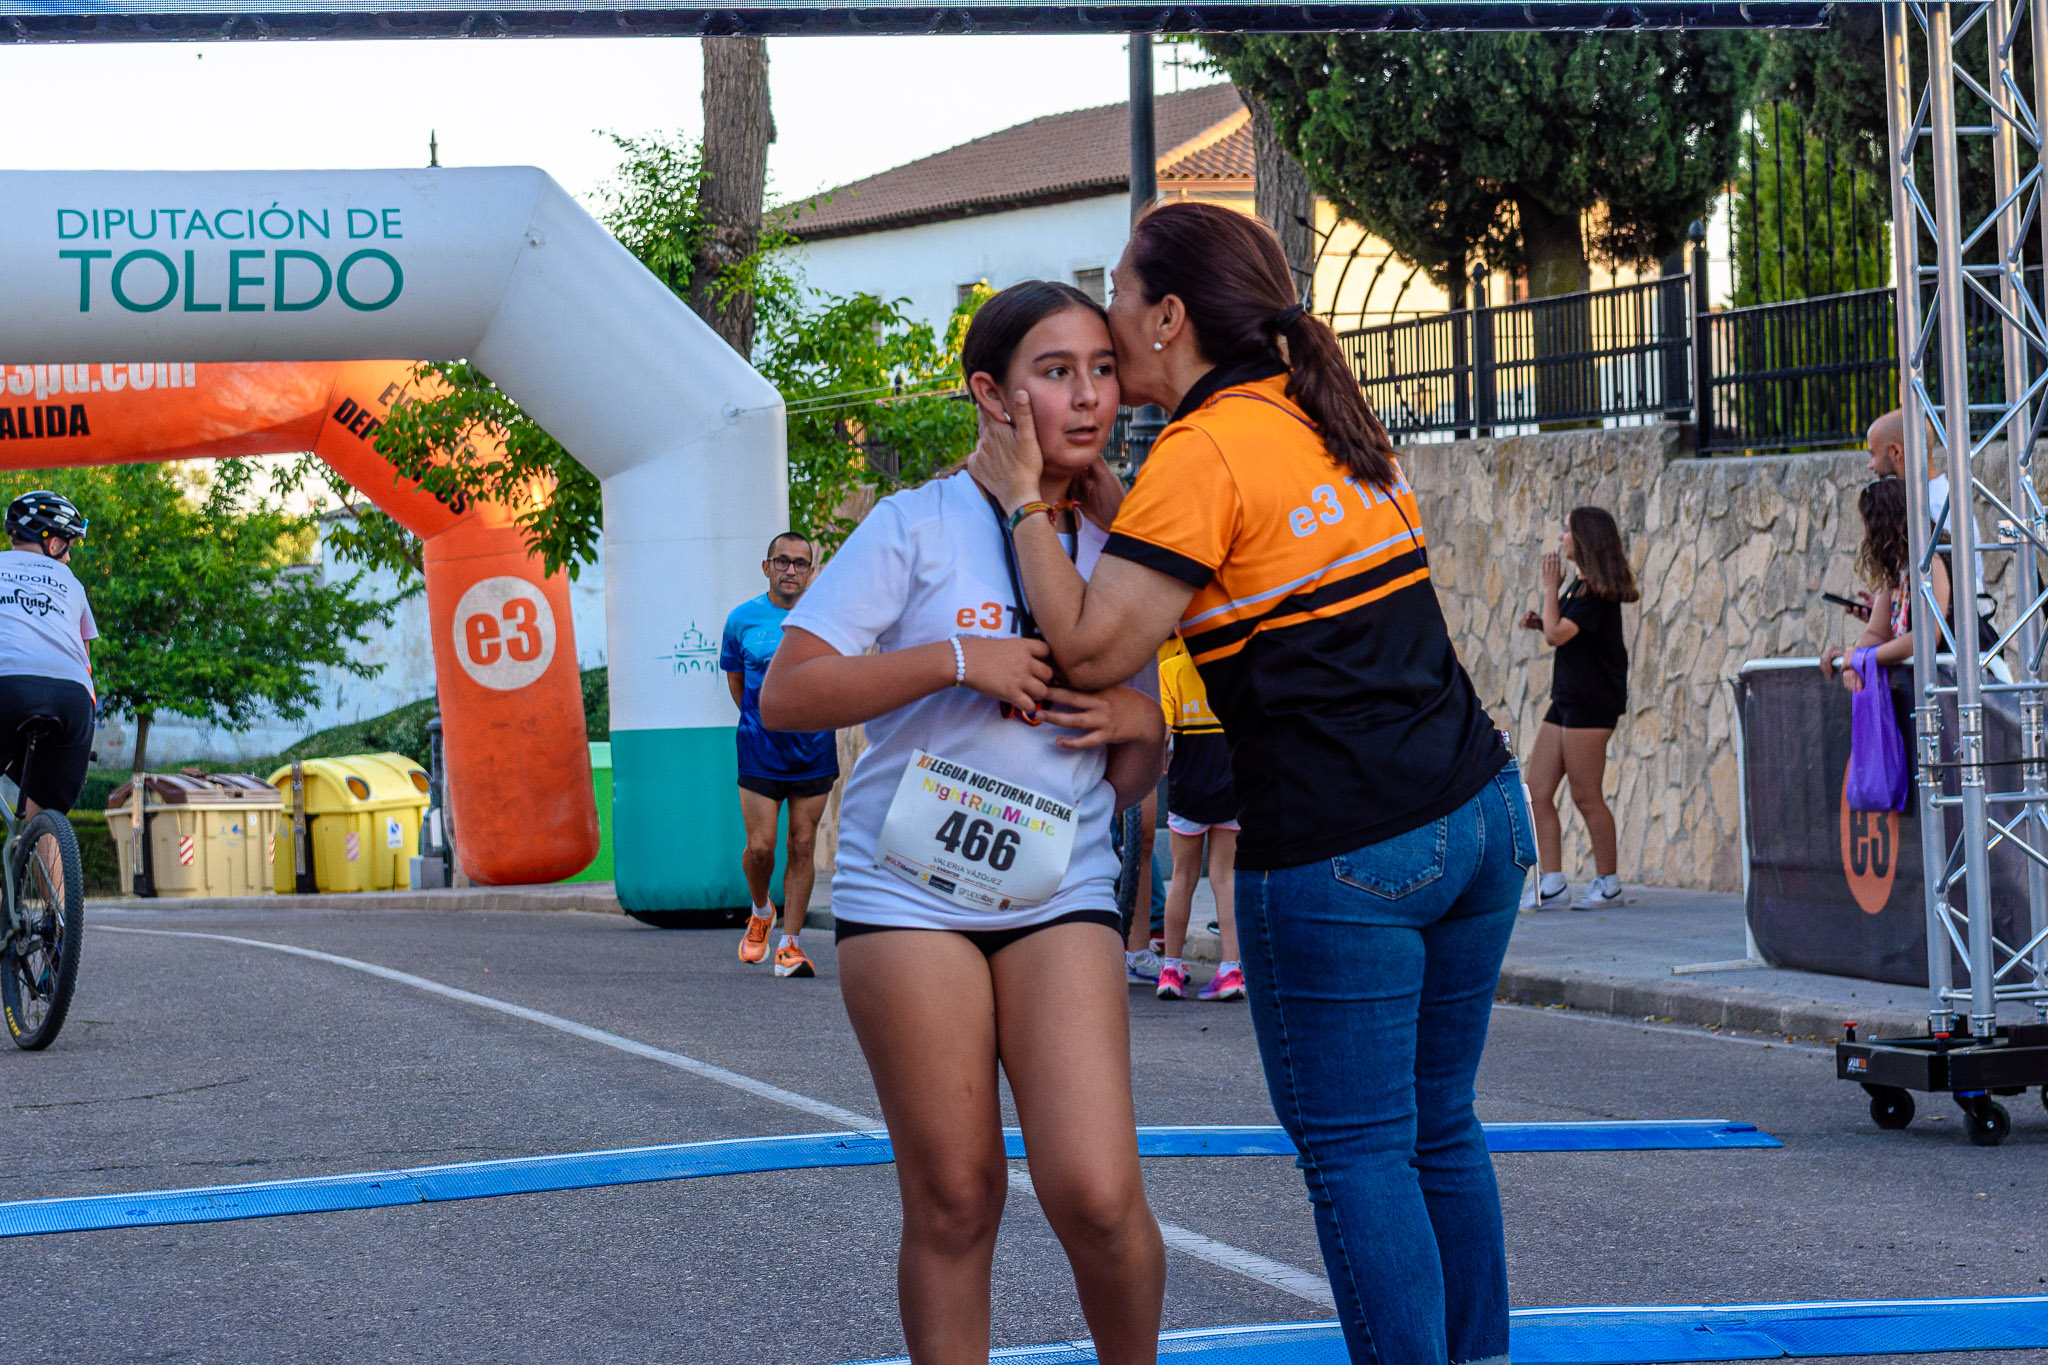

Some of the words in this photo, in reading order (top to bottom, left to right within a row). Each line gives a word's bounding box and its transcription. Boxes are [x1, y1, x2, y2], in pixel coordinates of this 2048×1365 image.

[57, 202, 330, 240] DIPUTACIÓN
[347, 208, 403, 239] DE
[59, 248, 404, 313] TOLEDO
[1288, 484, 1345, 538] e3
[465, 598, 543, 666] e3
[956, 601, 1003, 631] e3
[930, 759, 969, 783] LEGUA
[968, 772, 1034, 807] NOCTURNA
[1035, 797, 1072, 822] UGENA
[935, 810, 1021, 871] 466
